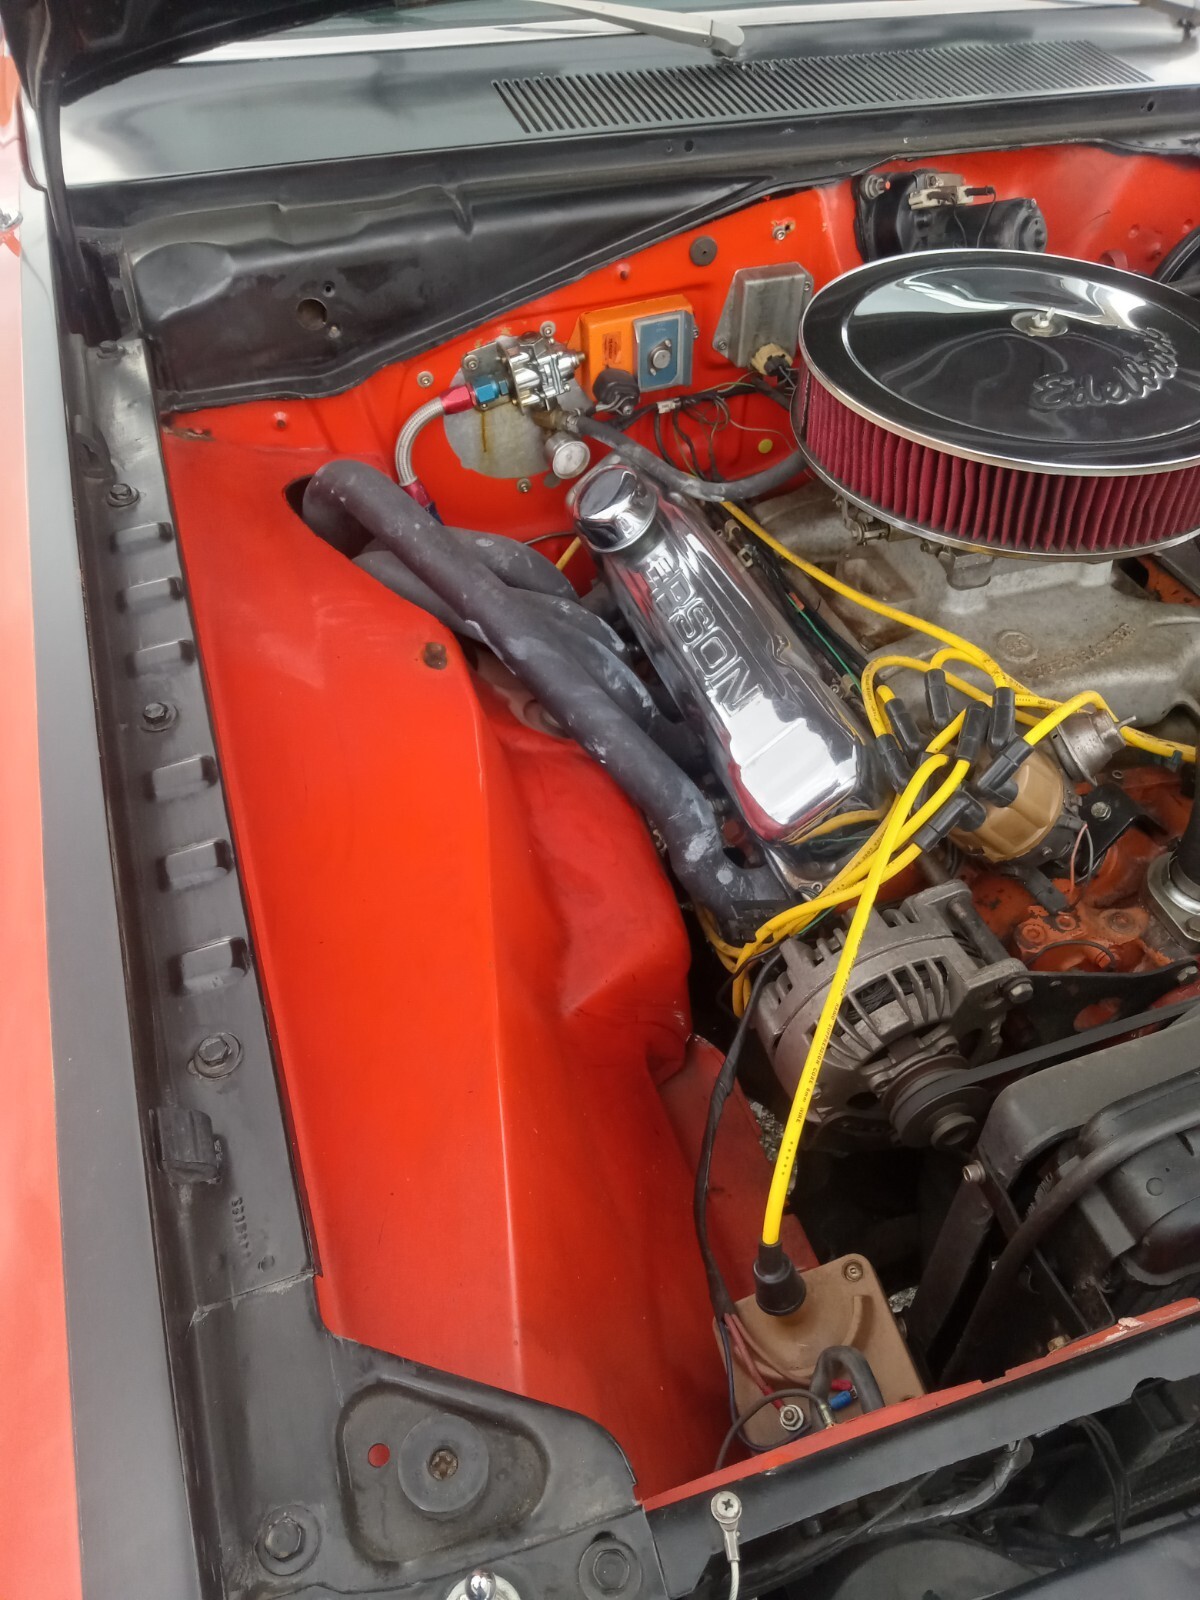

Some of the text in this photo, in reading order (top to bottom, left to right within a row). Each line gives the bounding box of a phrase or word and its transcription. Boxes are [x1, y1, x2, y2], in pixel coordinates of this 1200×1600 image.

[1032, 327, 1179, 410] Edelbrock
[815, 1023, 832, 1065] SUPPRESSION
[808, 1067, 818, 1084] CORE
[796, 1107, 805, 1124] WIRE
